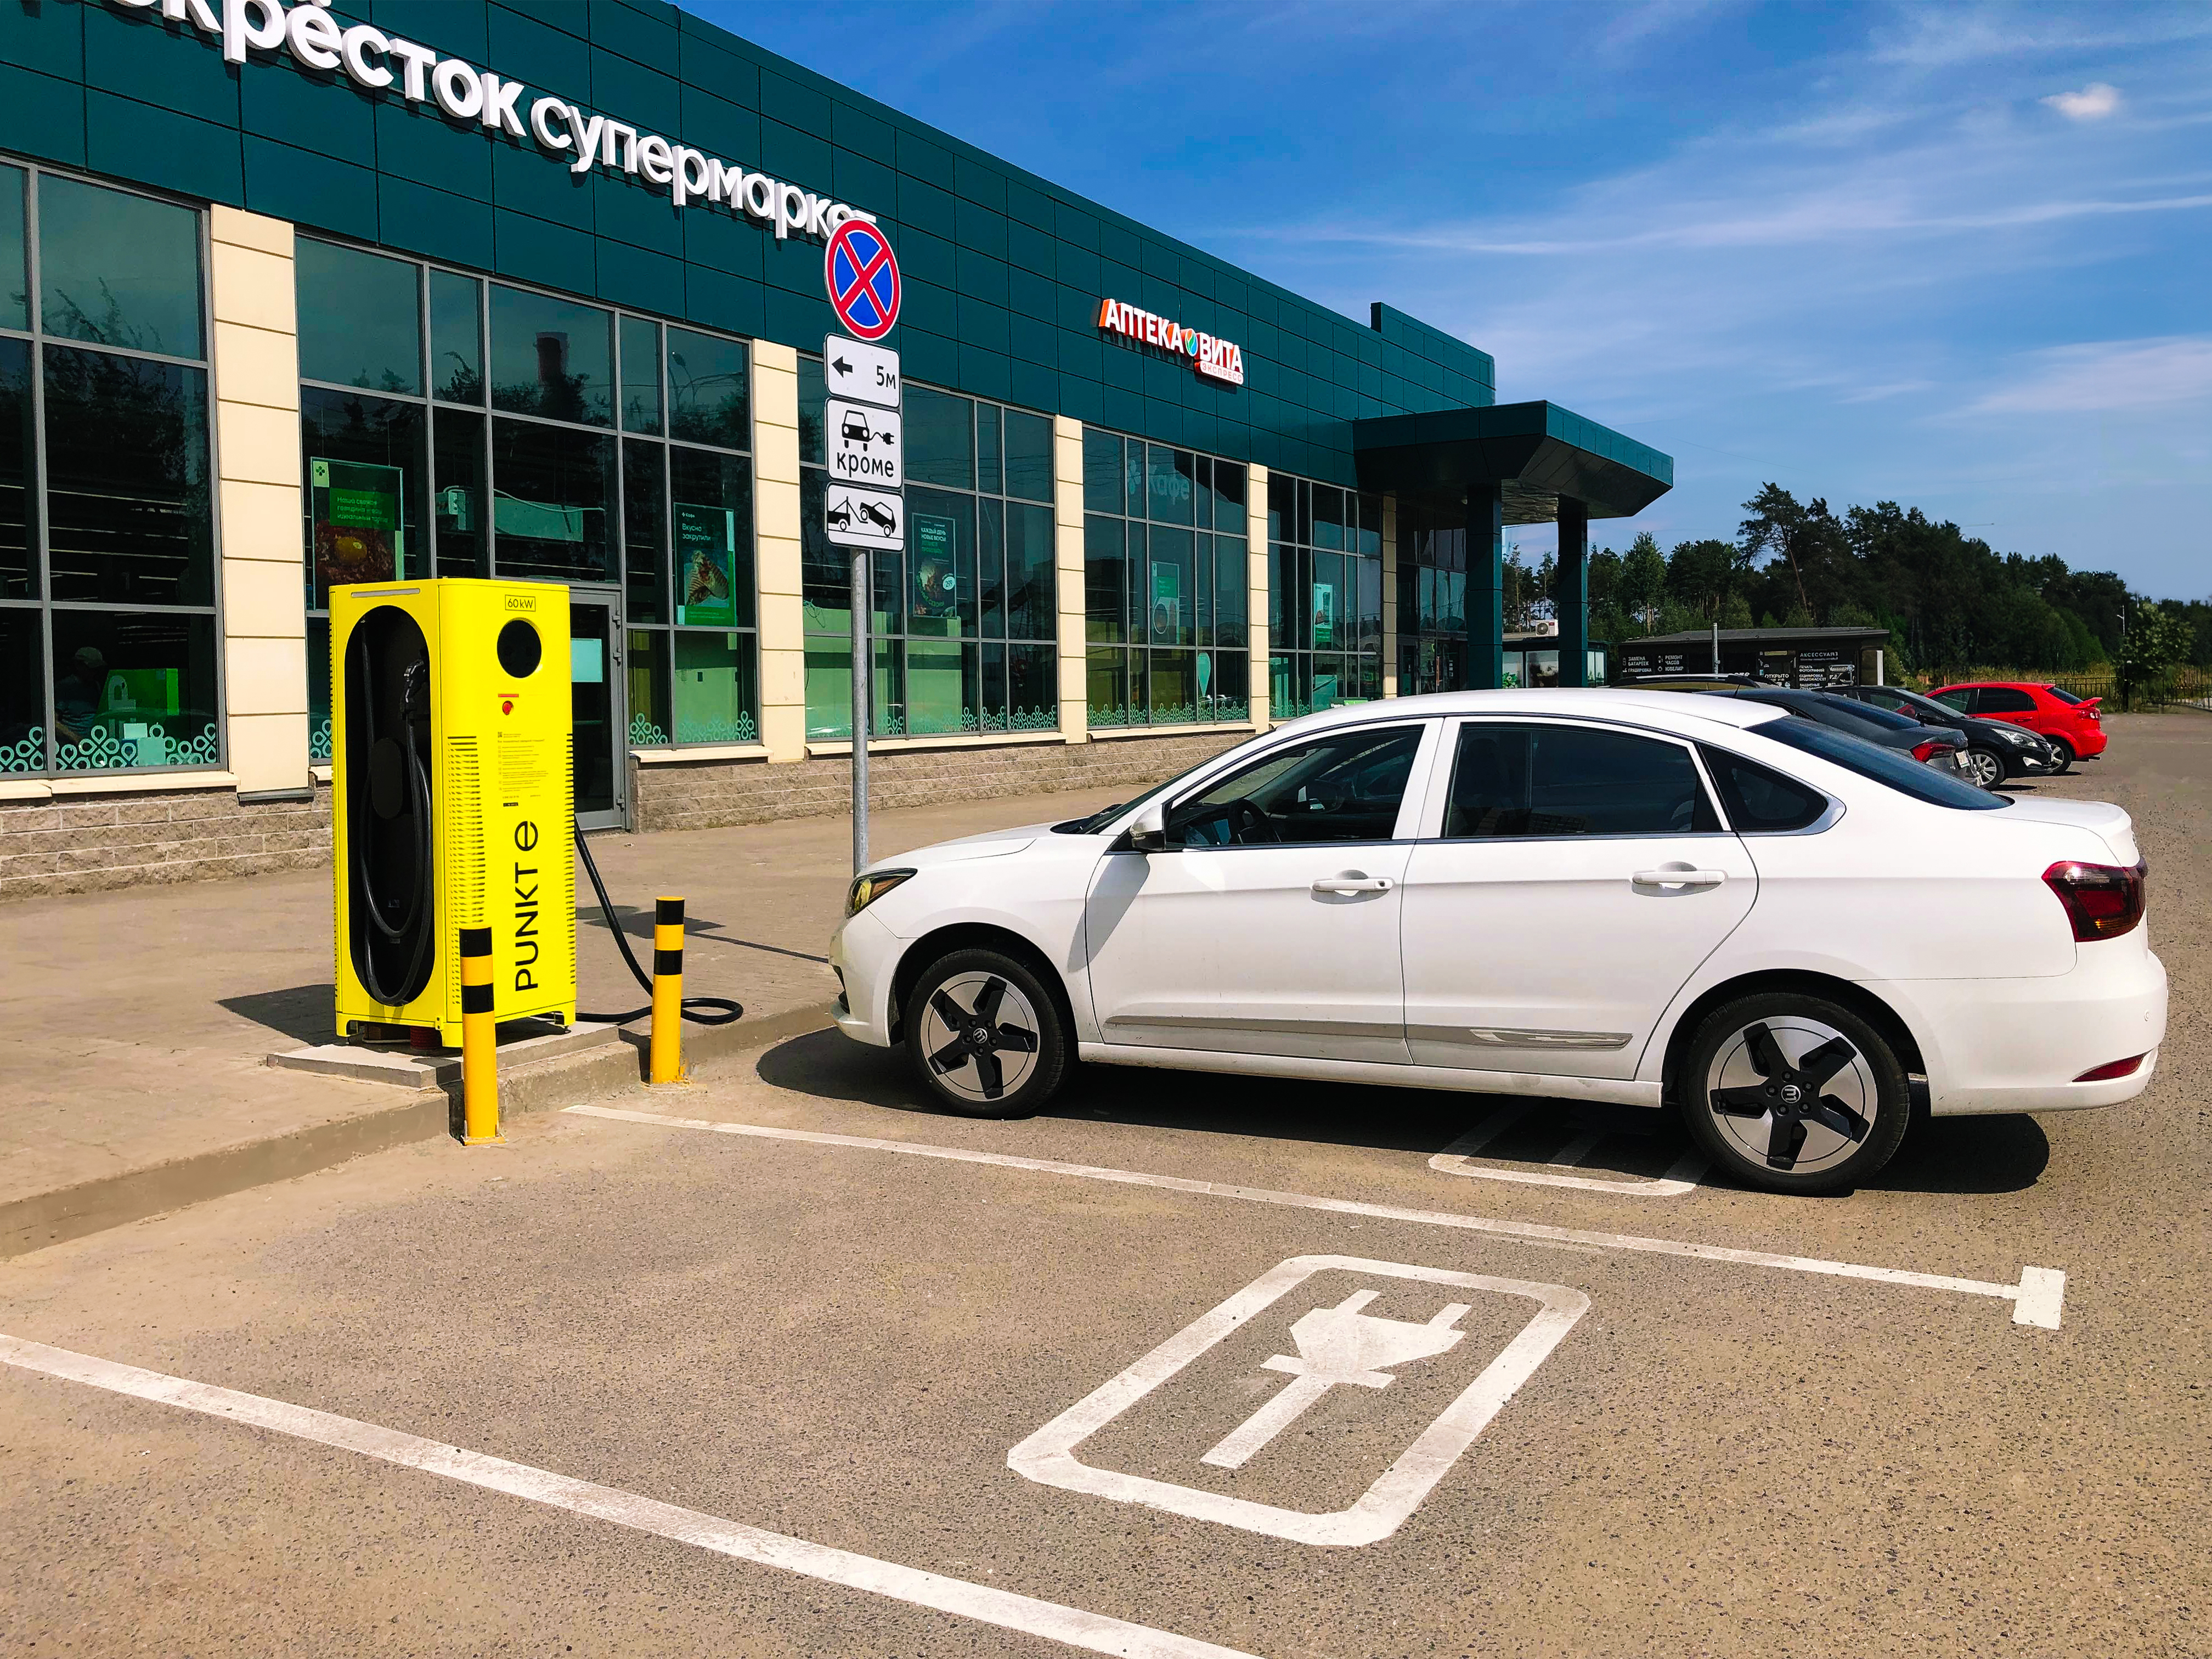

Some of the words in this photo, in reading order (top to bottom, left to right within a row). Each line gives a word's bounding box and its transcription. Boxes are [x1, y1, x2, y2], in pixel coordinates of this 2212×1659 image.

[1099, 298, 1184, 354] АПТЕКА
[1195, 332, 1244, 374] ВИТА
[876, 365, 896, 390] 5м
[1202, 362, 1242, 383] ЭКСПРЕСС
[837, 452, 894, 478] кроме
[682, 523, 702, 532] Вкусно
[515, 862, 539, 992] PUNKT
